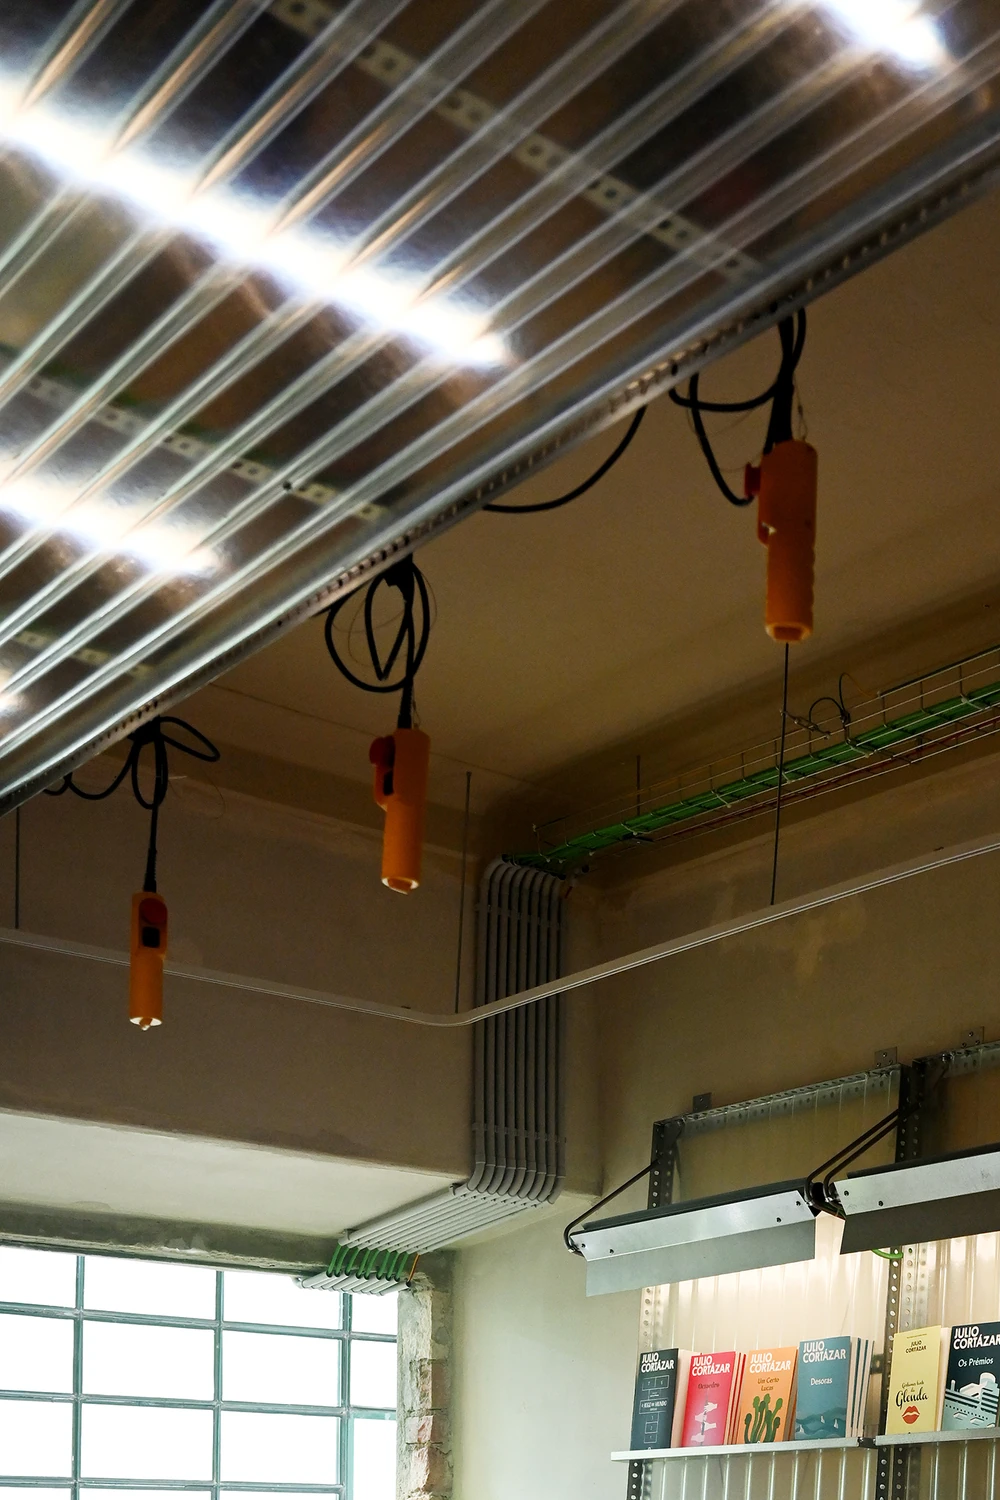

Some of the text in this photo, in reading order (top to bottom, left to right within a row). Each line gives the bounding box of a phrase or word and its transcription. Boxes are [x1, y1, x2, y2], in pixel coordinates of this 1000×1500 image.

[954, 1326, 979, 1339] JULIO
[803, 1341, 824, 1353] JULIO
[642, 1353, 659, 1363] JULIO
[693, 1356, 712, 1367] JULIO
[750, 1353, 772, 1364] JULIO
[803, 1349, 846, 1363] CORTÁZAR
[641, 1359, 675, 1373] CORTÁZAR
[692, 1363, 730, 1376] CORTÁZAR
[750, 1360, 791, 1373] CORTÁZAR
